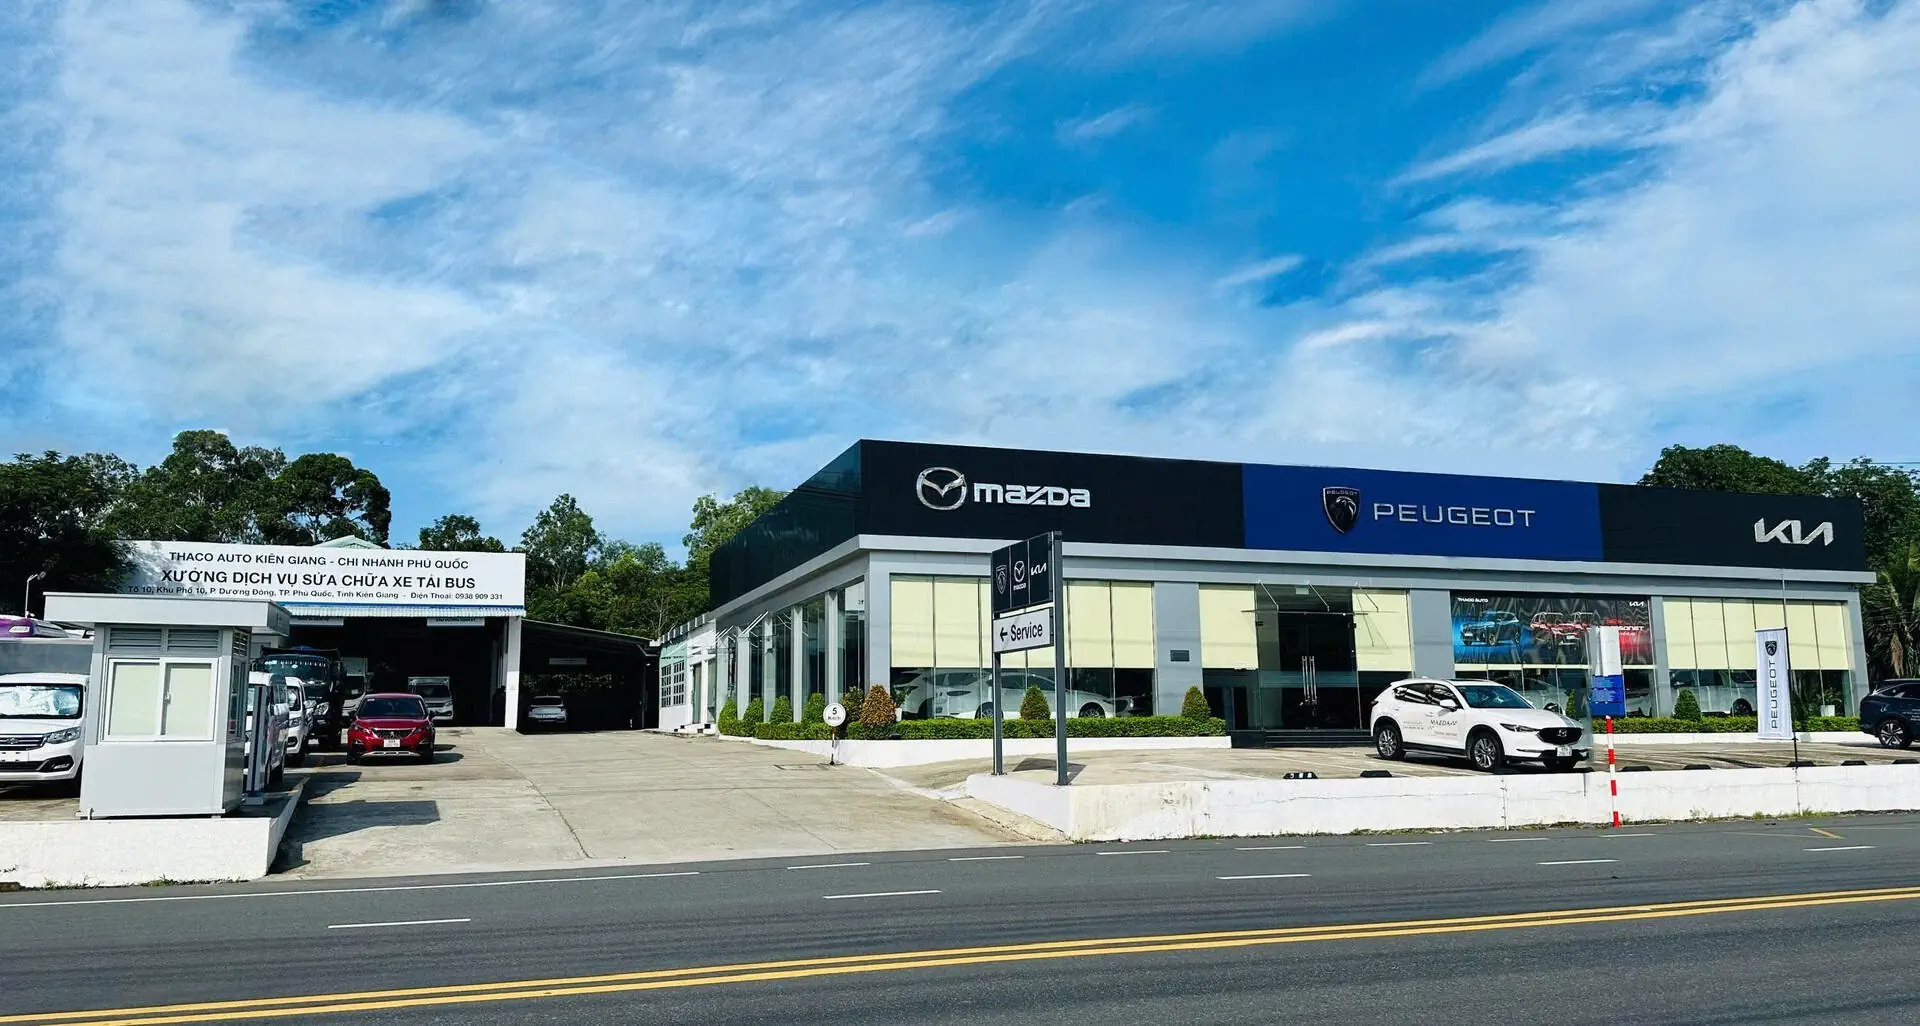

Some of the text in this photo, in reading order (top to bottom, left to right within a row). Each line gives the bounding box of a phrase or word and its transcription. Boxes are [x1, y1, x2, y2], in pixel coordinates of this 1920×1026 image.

[1373, 503, 1536, 527] PEUGEOT
[1754, 517, 1834, 546] KIA
[169, 552, 214, 562] THACO
[217, 553, 252, 563] AUTO
[288, 555, 327, 566] GIANG
[337, 557, 358, 567] CHI
[434, 557, 469, 570] QUỐC
[1030, 562, 1047, 576] KIA
[161, 567, 476, 589] XƯỞNG DỊCH VỤ SỬA CHỮA XE TẢI BUS
[156, 586, 174, 594] Khu
[196, 587, 208, 595] 10,
[219, 588, 250, 596] Dương
[376, 591, 399, 600] Giang
[1010, 621, 1043, 642] Service
[1768, 659, 1778, 729] PEUGEOT
[832, 707, 838, 715] 5
